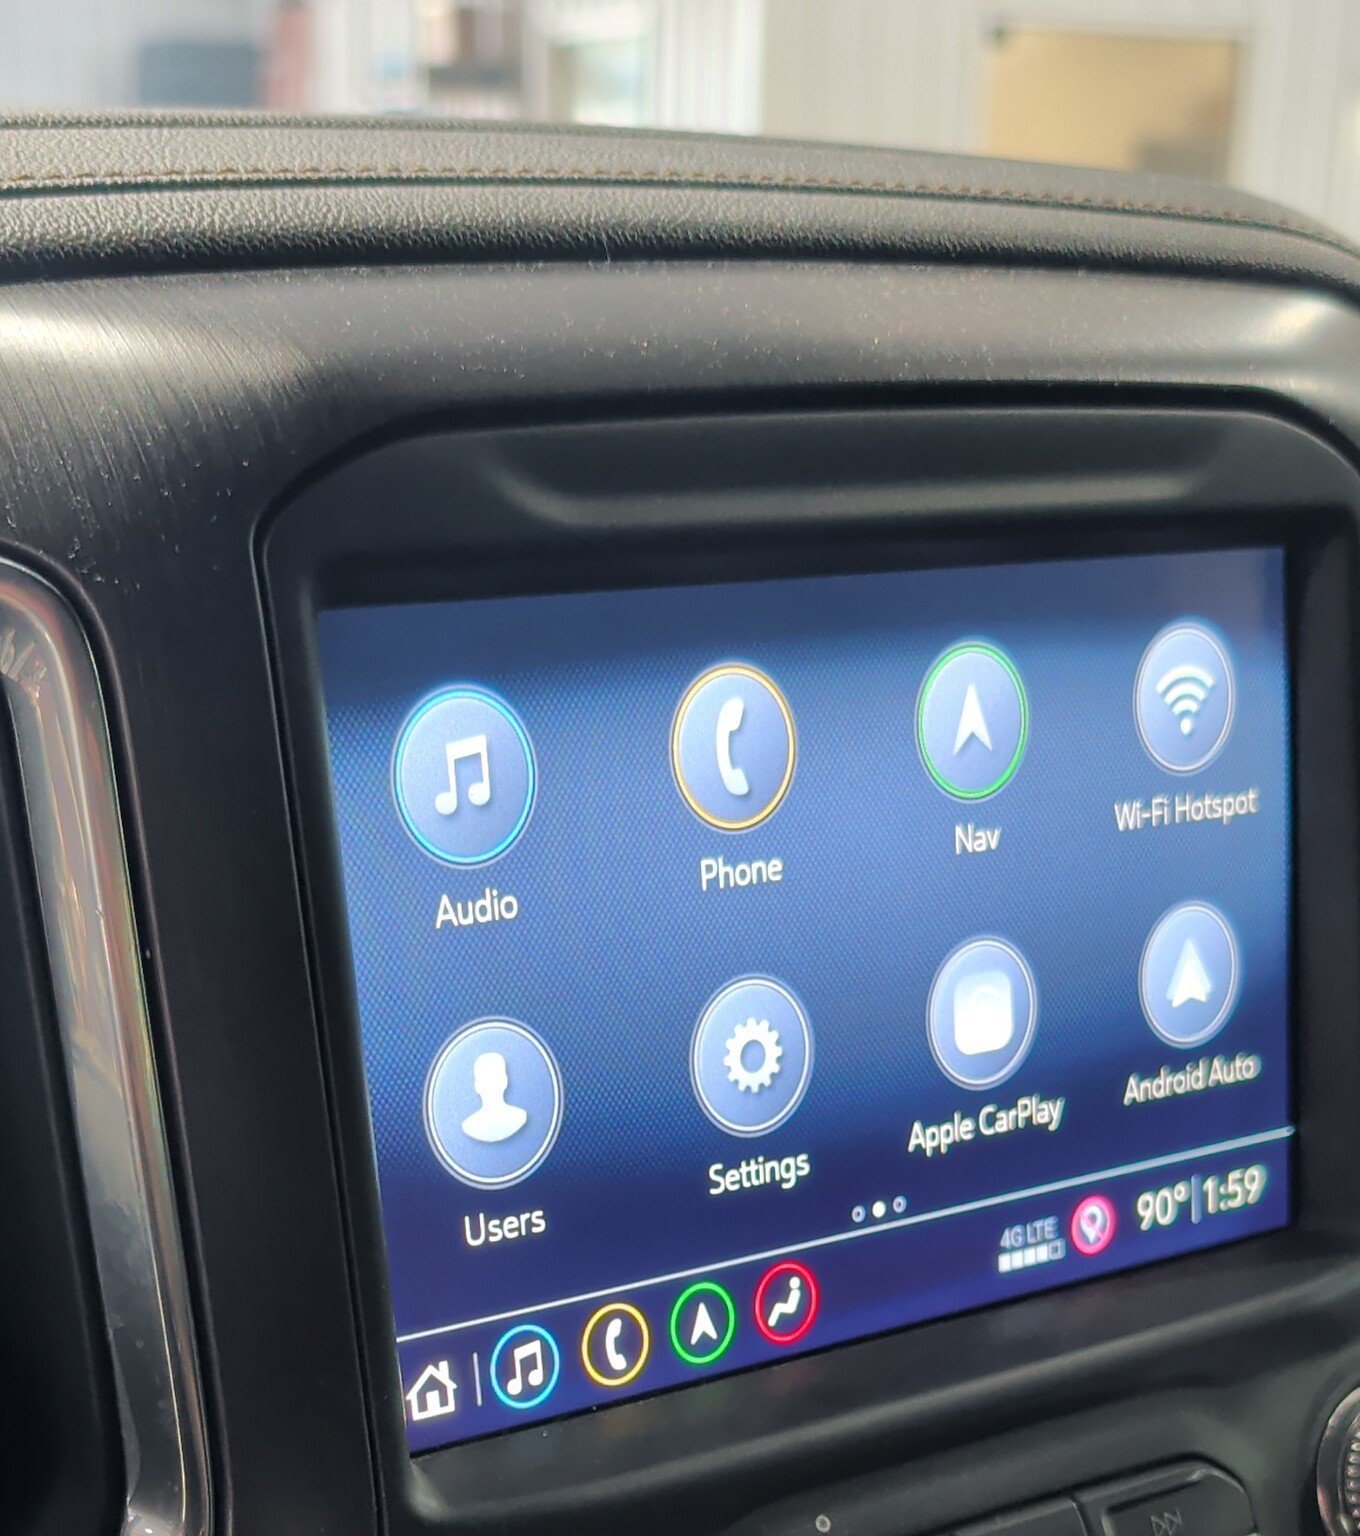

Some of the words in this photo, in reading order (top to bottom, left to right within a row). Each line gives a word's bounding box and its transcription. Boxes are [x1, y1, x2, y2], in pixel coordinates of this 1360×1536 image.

[1114, 794, 1170, 832] Wi-Fi
[1173, 788, 1259, 828] Hotspot
[953, 823, 1002, 856] Nav
[700, 856, 784, 891] Phone
[435, 888, 519, 929] Audio
[1123, 1057, 1207, 1106] Android
[1208, 1052, 1261, 1082] Auto
[906, 1111, 975, 1157] Apple
[978, 1094, 1066, 1136] CarPlay
[708, 1150, 812, 1197] Settings
[1203, 1164, 1267, 1214] 1:59
[463, 1207, 547, 1248] Users
[1135, 1186, 1191, 1231] 90°
[999, 1226, 1024, 1248] 4G
[1026, 1216, 1060, 1242] LTE
